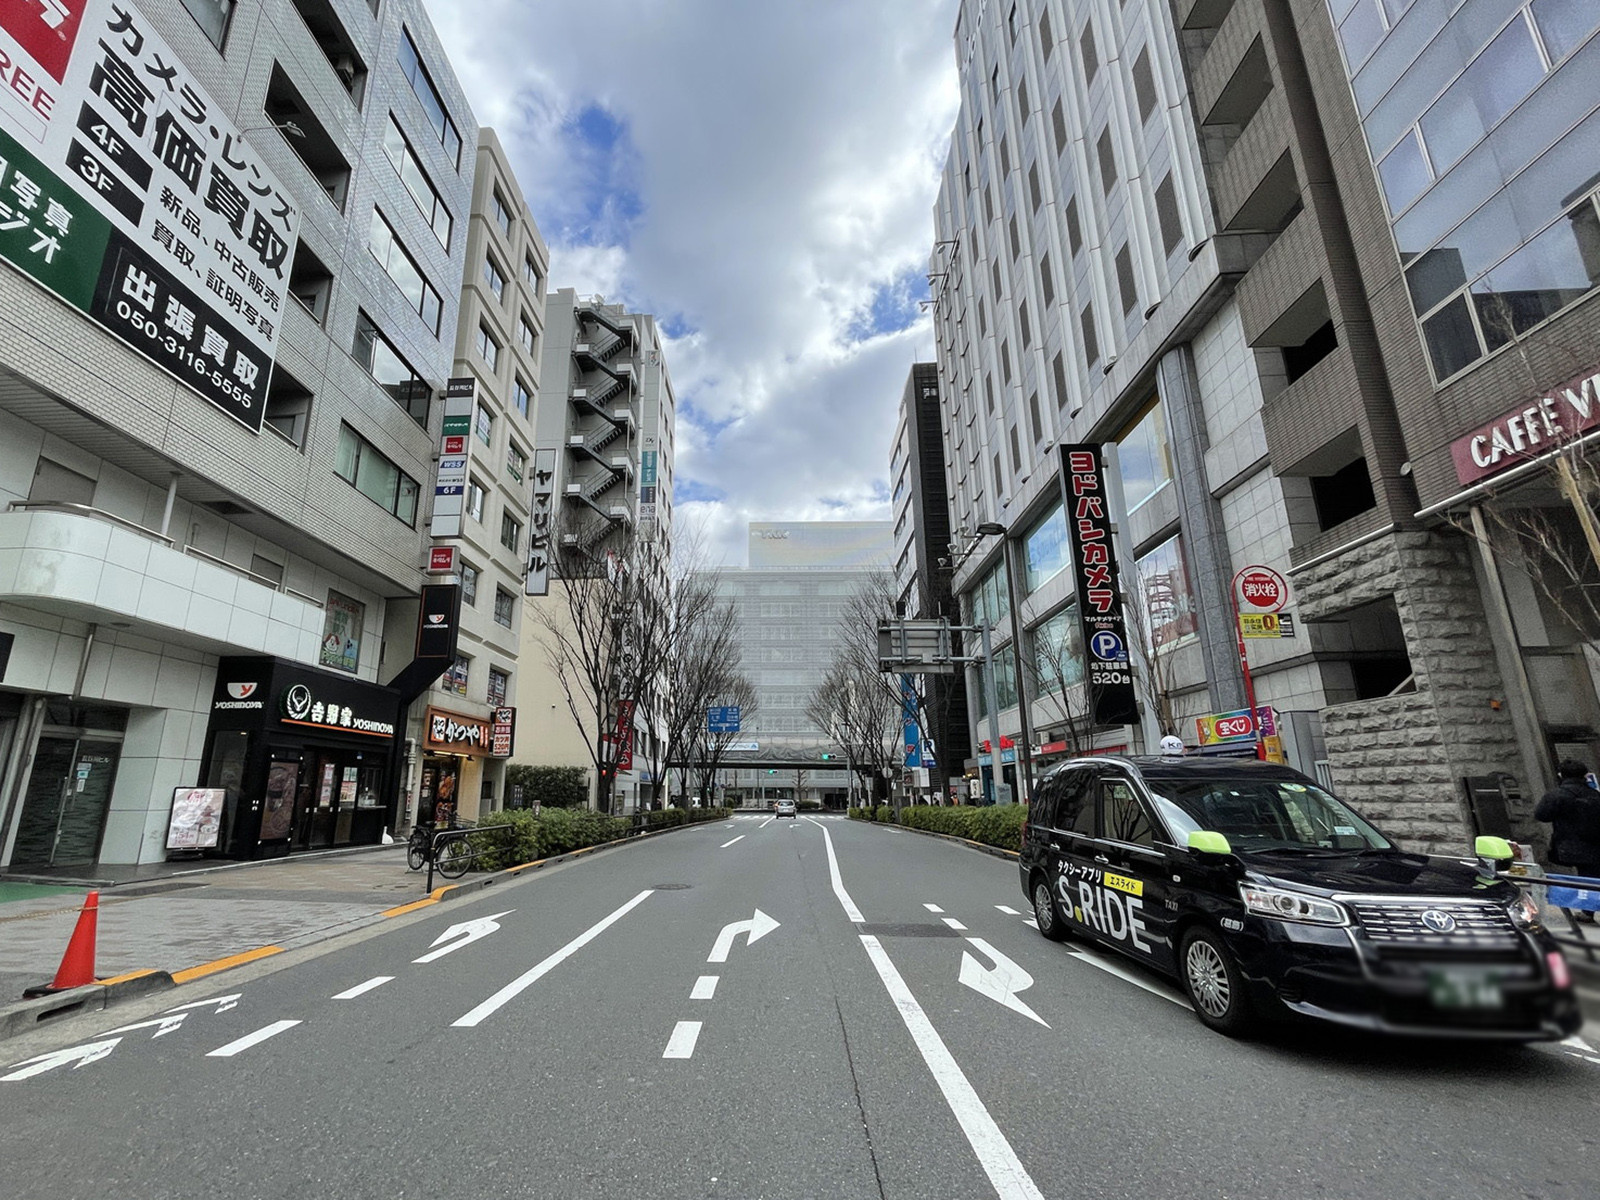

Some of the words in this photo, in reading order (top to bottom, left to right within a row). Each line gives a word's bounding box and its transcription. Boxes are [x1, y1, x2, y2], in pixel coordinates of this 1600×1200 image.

[88, 37, 290, 280] 高価買取
[90, 123, 124, 156] 4F
[106, 4, 297, 232] カメラ・レンズ
[0, 155, 73, 238] 写真
[79, 155, 115, 195] 3F
[150, 219, 275, 341] 買取、証明写真
[160, 186, 280, 312] 新品、中古販売
[116, 301, 252, 409] 050-3116-5555
[122, 264, 260, 390] 出張買取
[1470, 397, 1563, 468] CAFFE
[1561, 373, 1600, 419] V
[1069, 451, 1113, 613] ヨドバシカメラ
[1244, 583, 1277, 597] 消火栓
[1092, 672, 1130, 684] 520台
[446, 718, 479, 745] かつや
[1058, 860, 1101, 883] タクシーアプリ
[1110, 876, 1136, 890] エスライド
[1165, 899, 1178, 912] TAXI
[1059, 875, 1152, 954] S.RIDE
